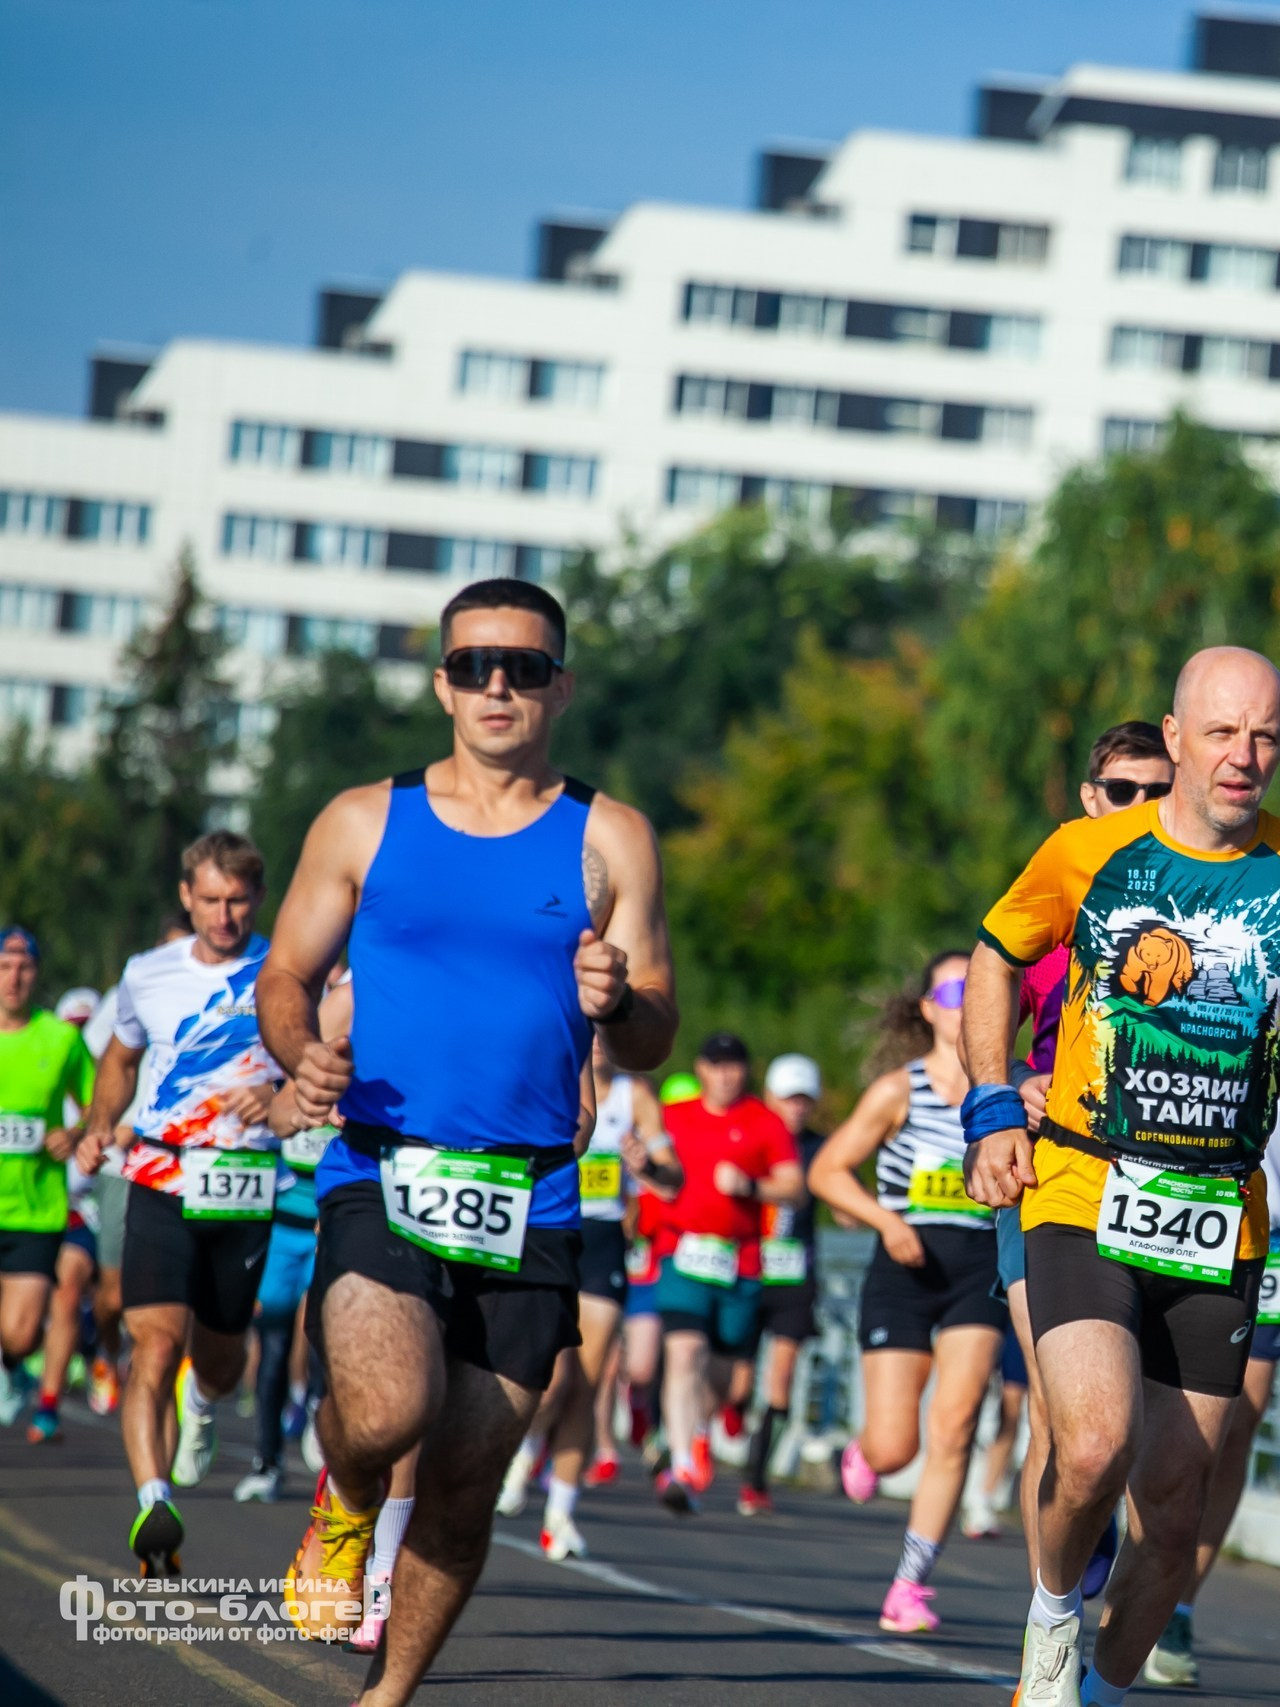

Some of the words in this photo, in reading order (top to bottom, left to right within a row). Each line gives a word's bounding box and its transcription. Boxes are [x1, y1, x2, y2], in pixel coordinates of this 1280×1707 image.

[1127, 869, 1156, 880] 18.10
[1127, 880, 1156, 891] 2025
[1180, 1023, 1237, 1040] КРАСНОЯРСК
[1124, 1067, 1250, 1103] ХОЗЯИН
[1136, 1097, 1238, 1129] ТАЙГИ
[1135, 1130, 1205, 1147] СОРЕВНОВАНИЯ
[1121, 1154, 1185, 1172] performance
[198, 1173, 263, 1199] 1371
[924, 1175, 965, 1199] 112
[394, 1184, 514, 1237] 1285
[1107, 1194, 1228, 1250] 1340
[1129, 1240, 1175, 1255] АГАФОНОВ
[1175, 1248, 1198, 1258] ОЛЕГ
